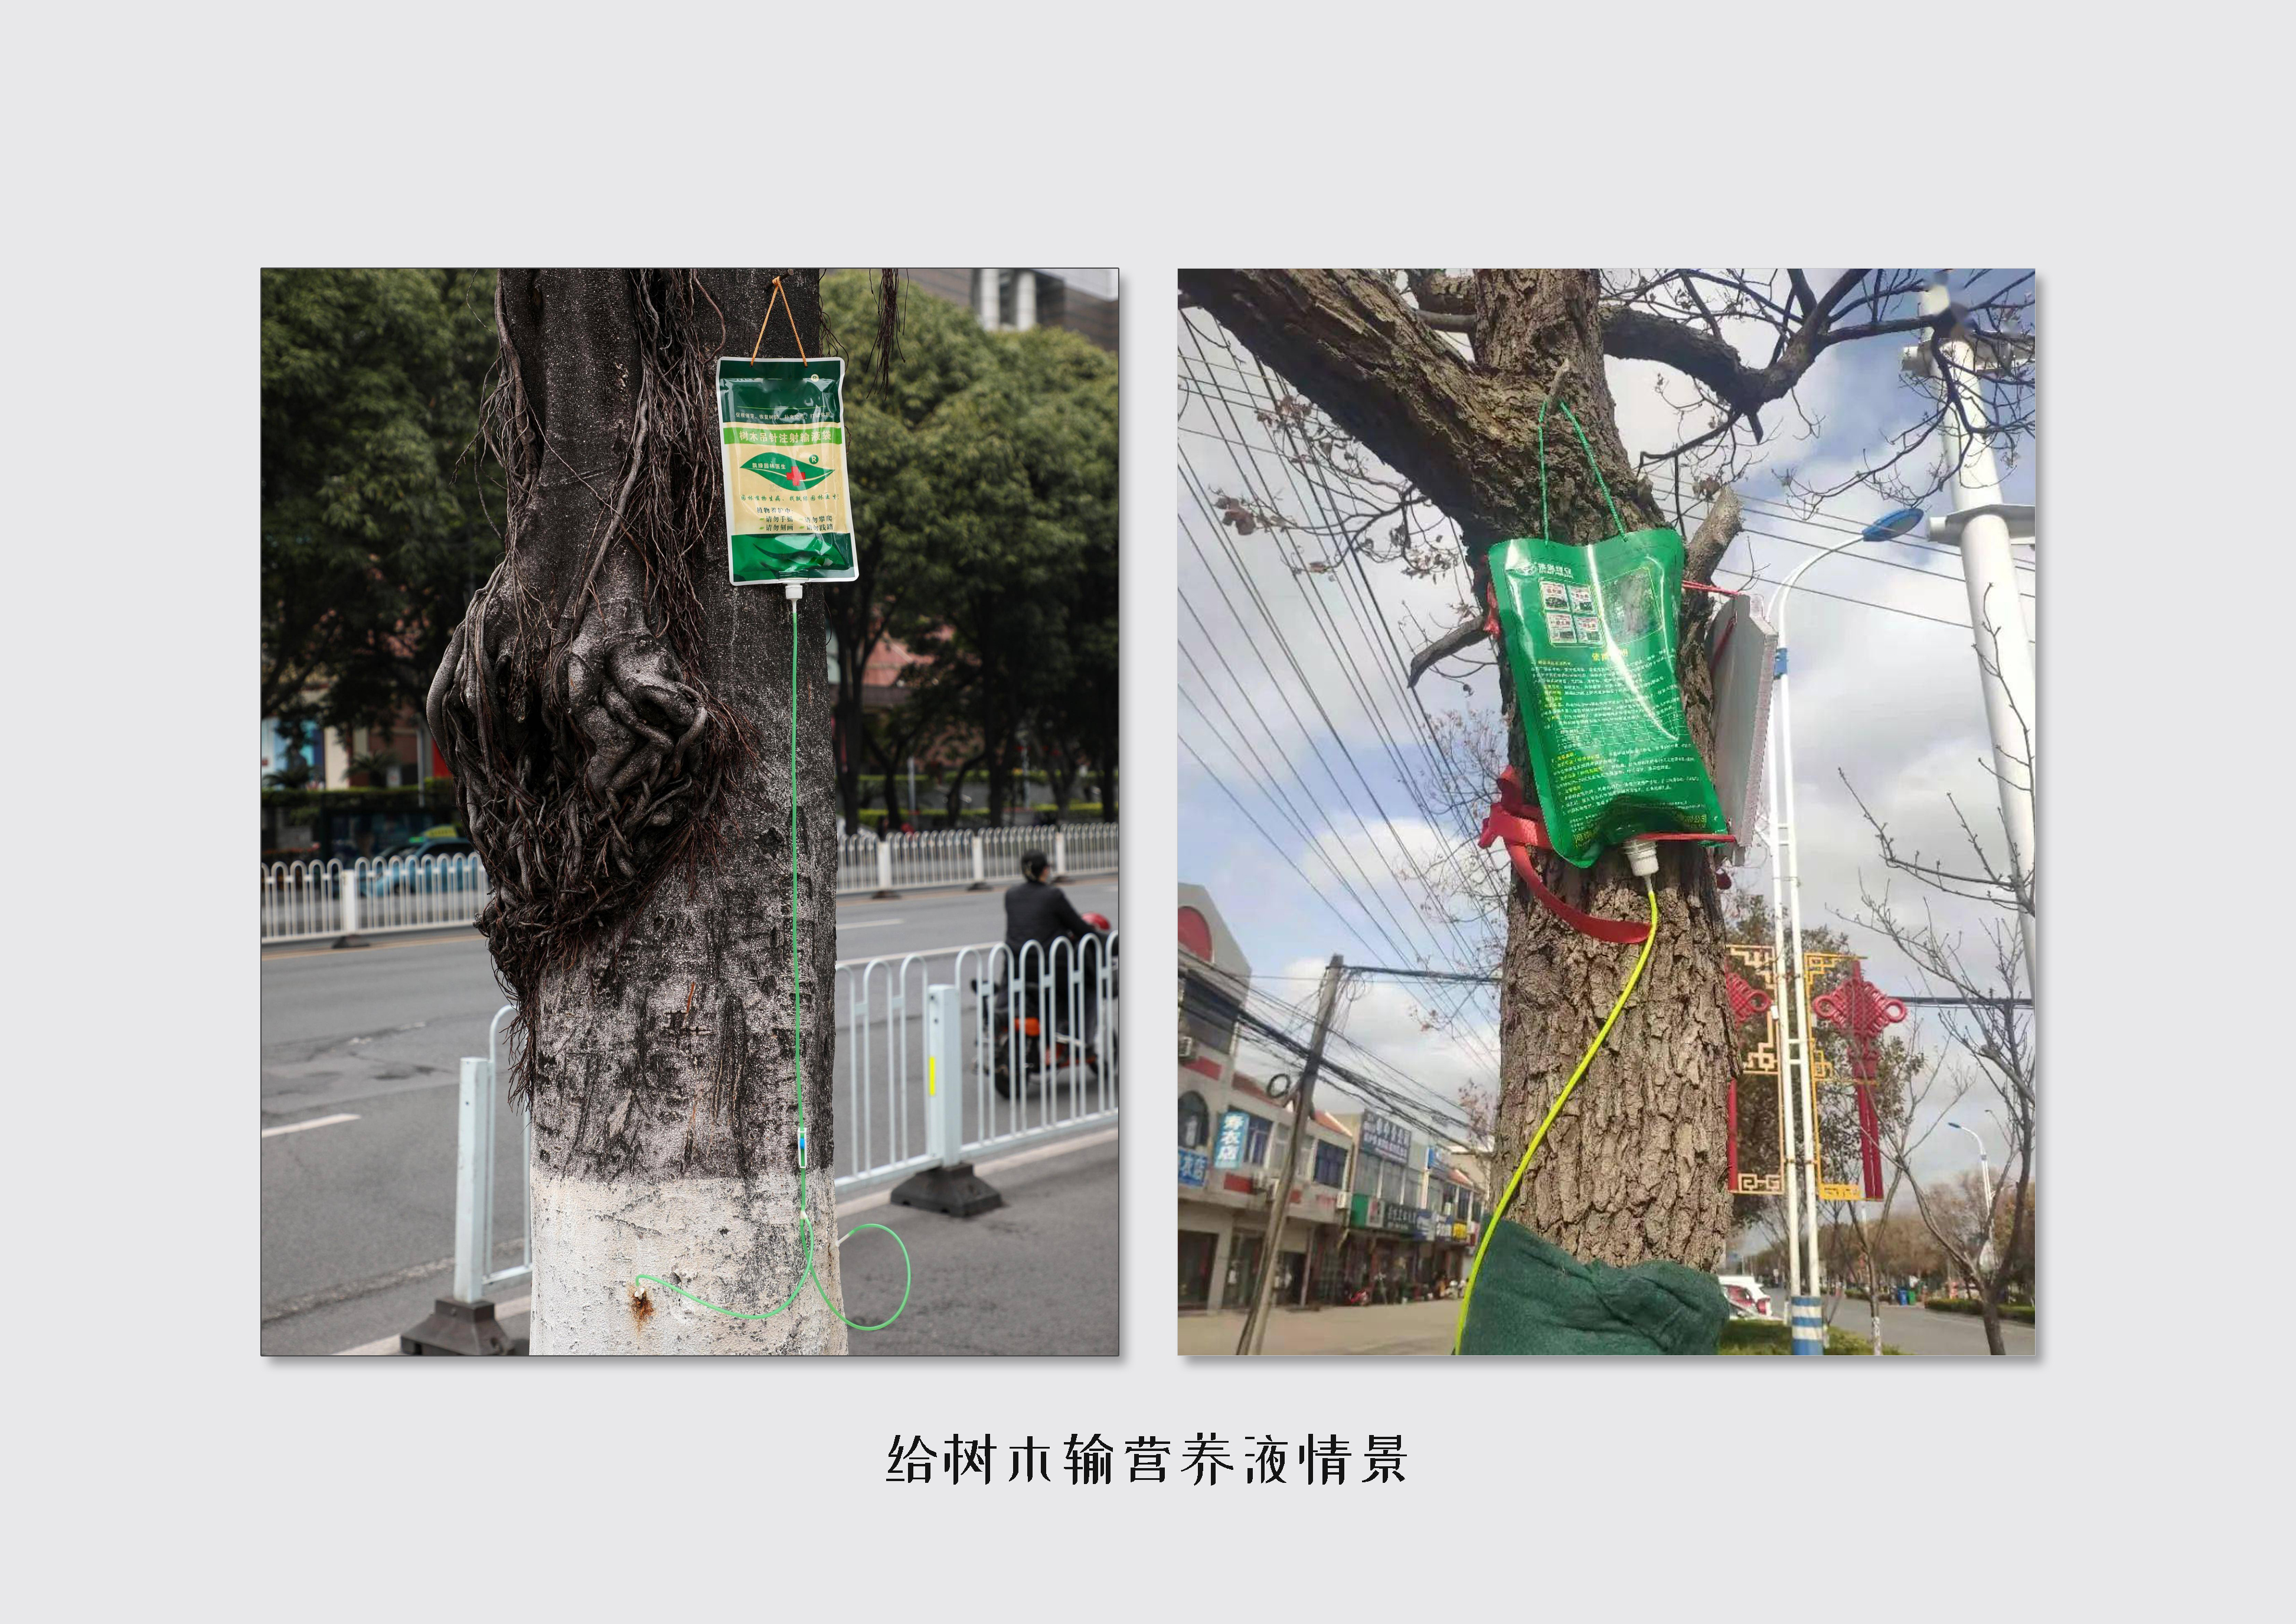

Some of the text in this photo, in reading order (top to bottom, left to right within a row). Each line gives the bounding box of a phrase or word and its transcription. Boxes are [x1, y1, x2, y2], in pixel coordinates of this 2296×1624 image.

[739, 430, 831, 443] 树木吊针注射输液袋
[805, 515, 833, 523] 请勿攀爬
